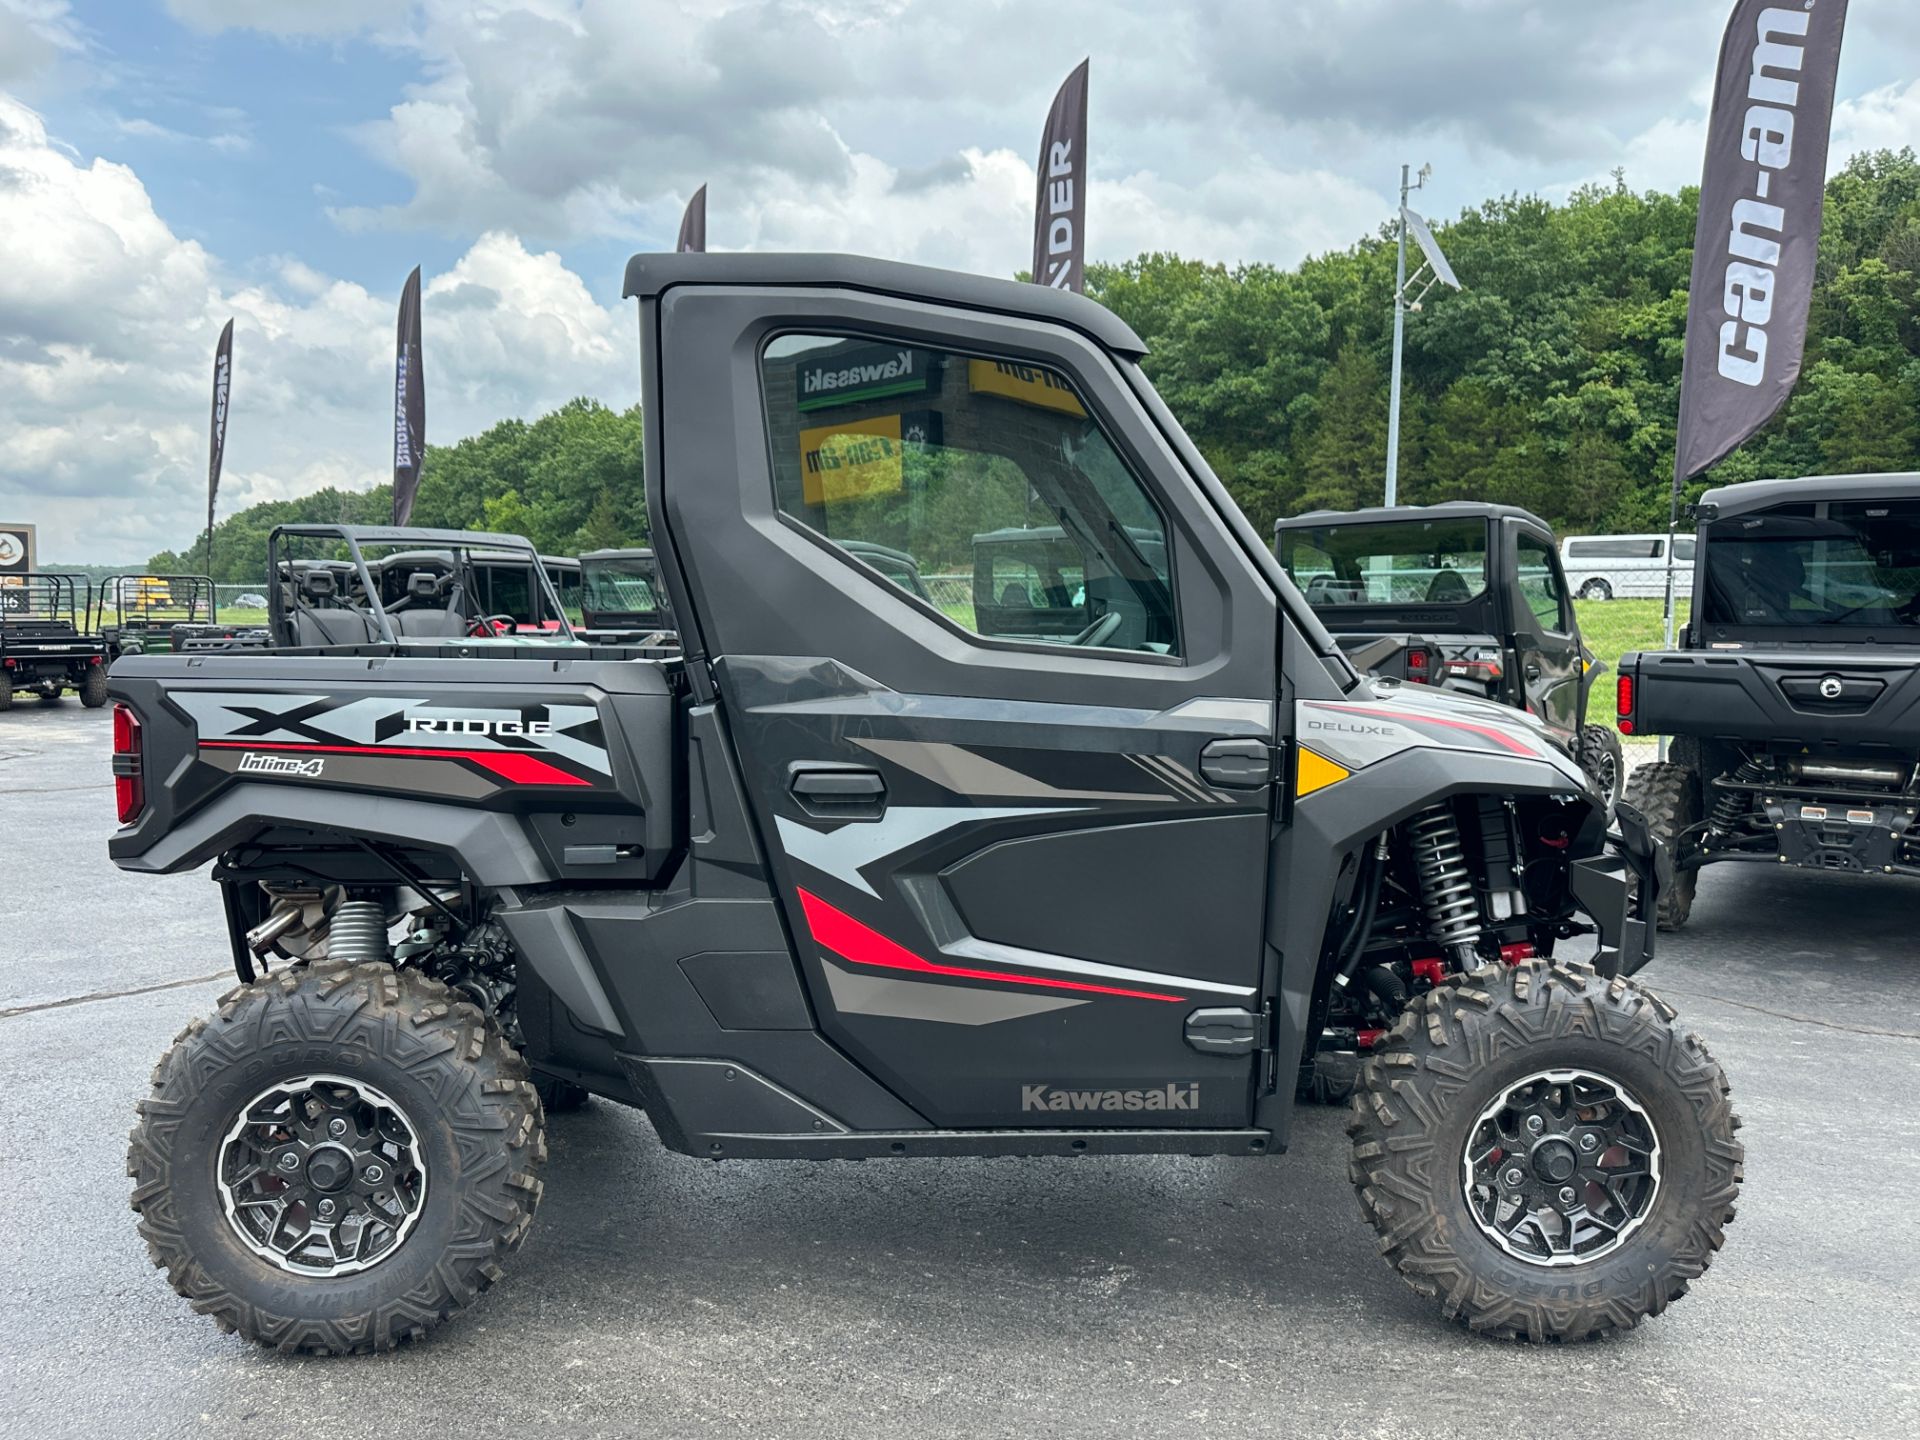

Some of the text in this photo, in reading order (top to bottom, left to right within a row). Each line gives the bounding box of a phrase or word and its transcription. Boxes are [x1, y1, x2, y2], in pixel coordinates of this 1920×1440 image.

[1717, 7, 1810, 387] can-am
[409, 717, 552, 737] RIDGE
[1308, 720, 1395, 736] DELUXE
[238, 752, 324, 776] Inline-4
[1021, 1083, 1199, 1111] Kawasaki
